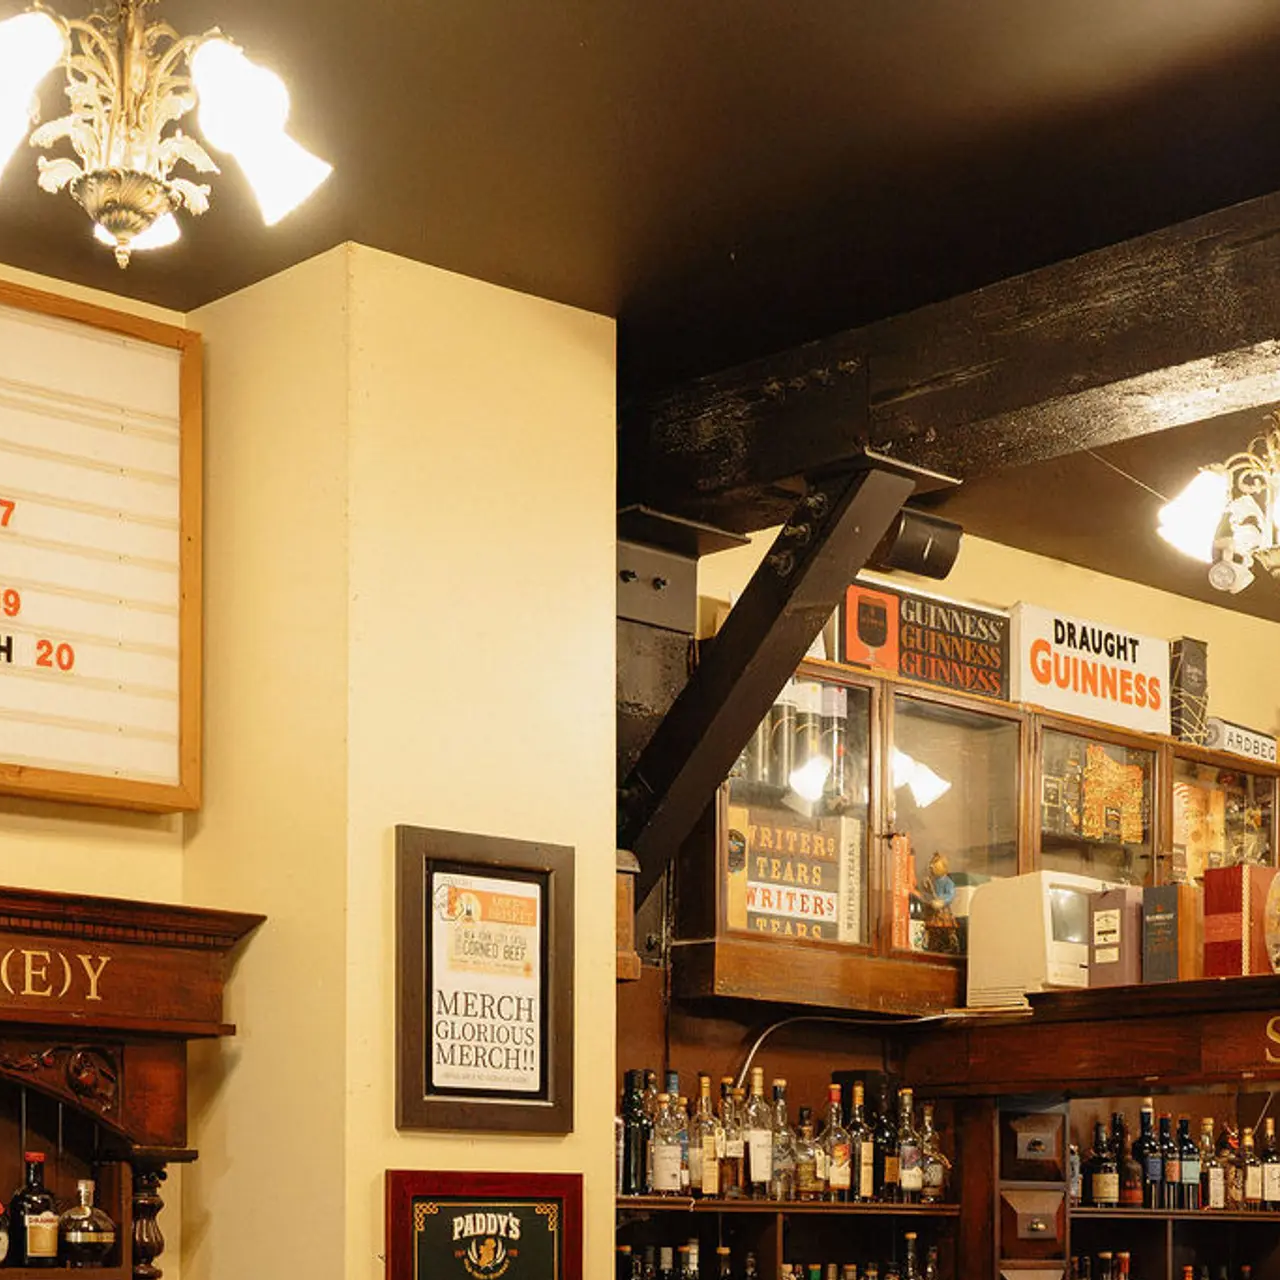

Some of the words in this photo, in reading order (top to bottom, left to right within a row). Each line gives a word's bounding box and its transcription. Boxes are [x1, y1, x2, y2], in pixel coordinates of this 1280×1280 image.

[900, 598, 1002, 644] GUINNESS
[35, 637, 75, 671] 20
[901, 624, 1002, 669] GUINNESS
[1053, 617, 1140, 664] DRAUGHT
[901, 651, 1002, 697] GUINNESS
[1029, 637, 1162, 712] GUINNESS
[1226, 730, 1276, 762] ARDBEG
[756, 856, 822, 886] TEARS
[462, 939, 499, 959] CORNED
[503, 944, 527, 961] BEEF
[436, 990, 535, 1023] MERCH
[435, 1019, 535, 1046] GLORIOUS
[435, 1043, 535, 1072] MERCH!!
[452, 1212, 521, 1241] PADDY'S
